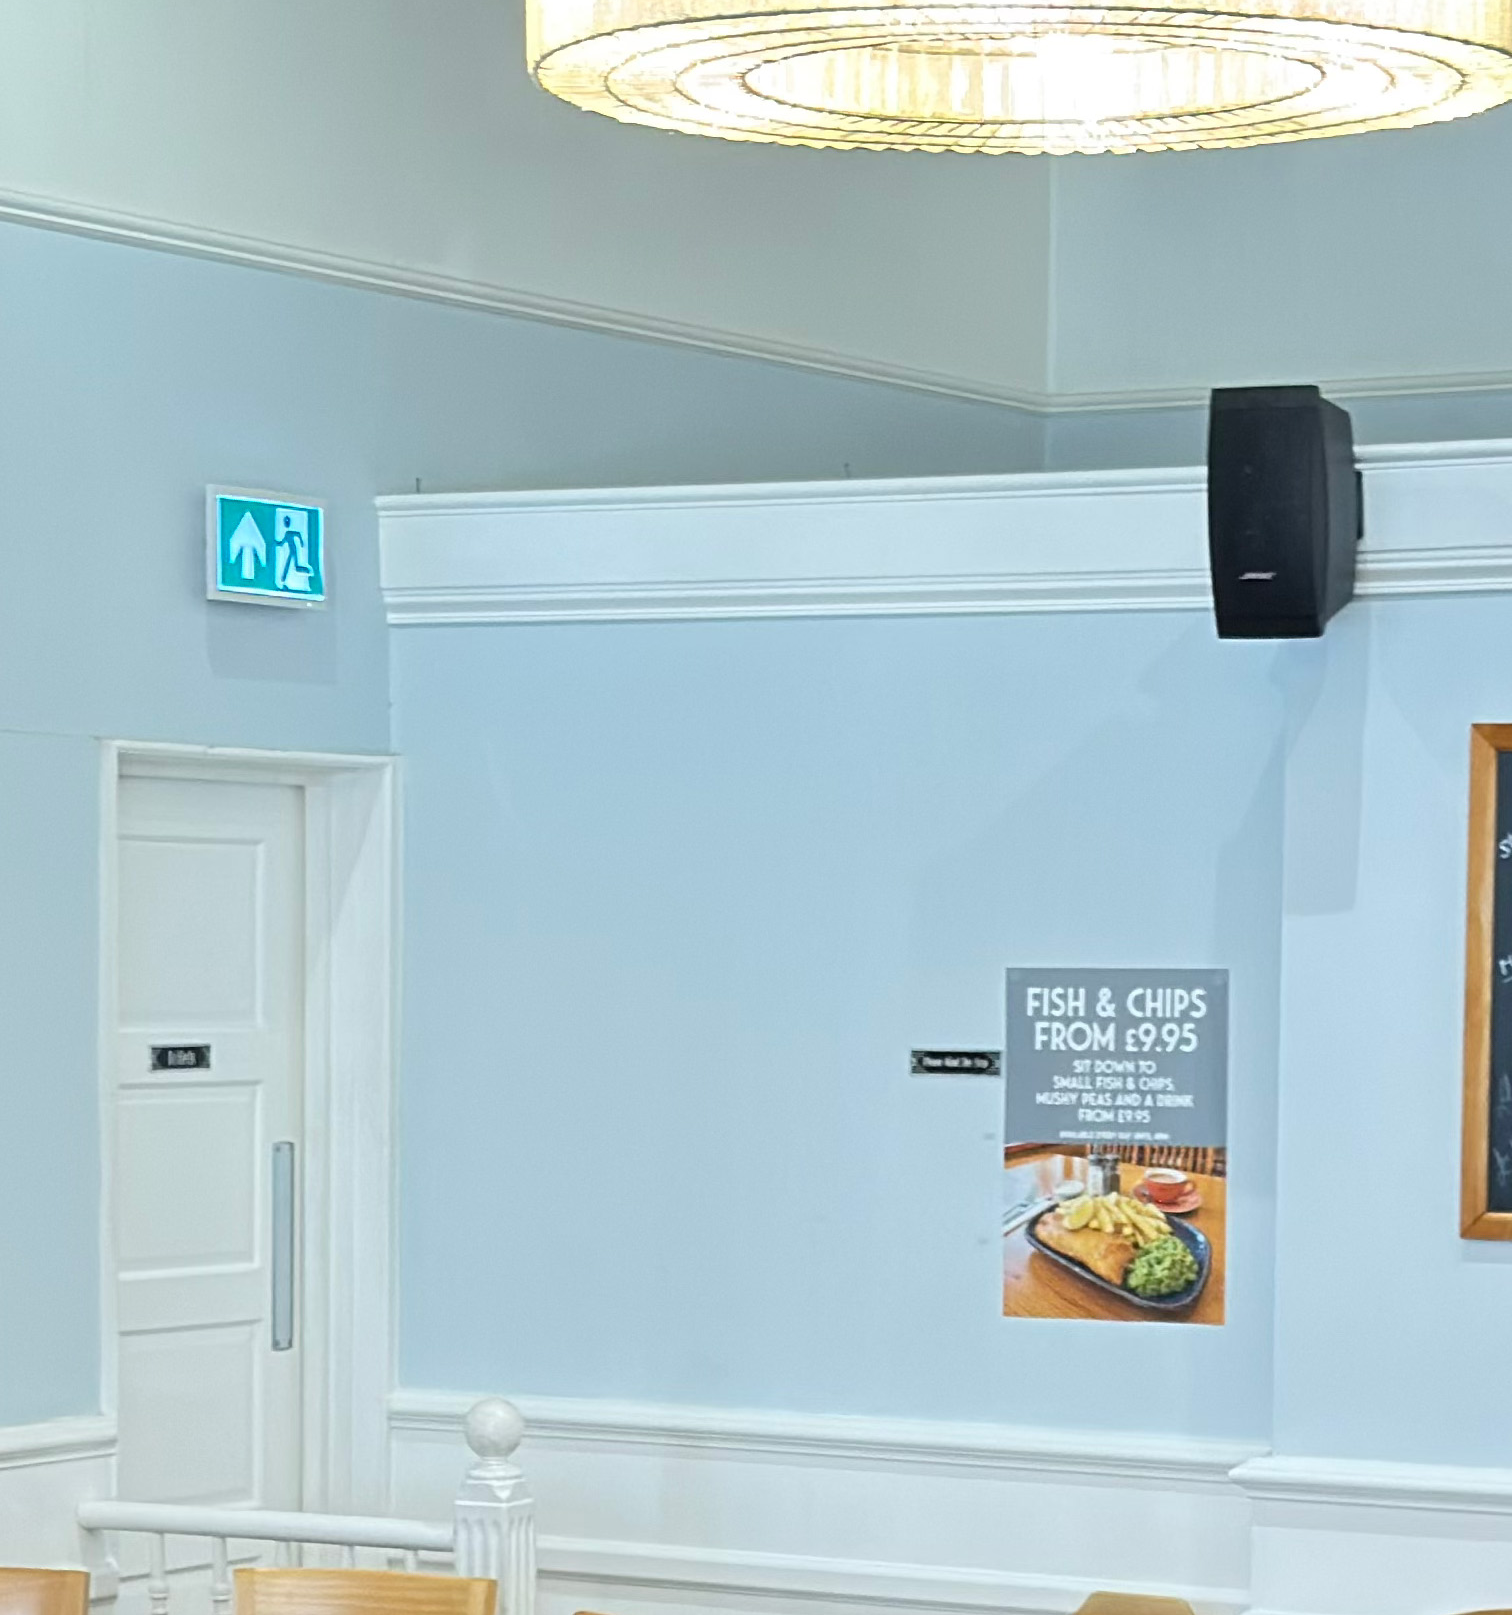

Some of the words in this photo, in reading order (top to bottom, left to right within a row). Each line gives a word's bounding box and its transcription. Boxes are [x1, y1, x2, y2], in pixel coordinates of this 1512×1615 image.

[1027, 987, 1086, 1017] FISH
[1095, 987, 1116, 1018] &
[1126, 987, 1207, 1018] CHIPS
[1034, 1021, 1116, 1052] FROM
[1124, 1022, 1199, 1053] £9.95
[1072, 1059, 1092, 1074] SIT
[1094, 1059, 1136, 1074] DOWN
[1138, 1060, 1157, 1074] TO
[1052, 1075, 1093, 1090] SMALL
[1096, 1075, 1124, 1090] FISH
[1126, 1076, 1136, 1091] &
[1035, 1092, 1079, 1106] MUSHY
[1081, 1092, 1113, 1107] PEAS
[1114, 1092, 1142, 1107] AND
[1144, 1093, 1155, 1107] A
[1156, 1094, 1195, 1108] DRINK
[1077, 1108, 1115, 1123] FROM
[1117, 1109, 1152, 1124] £9.95
